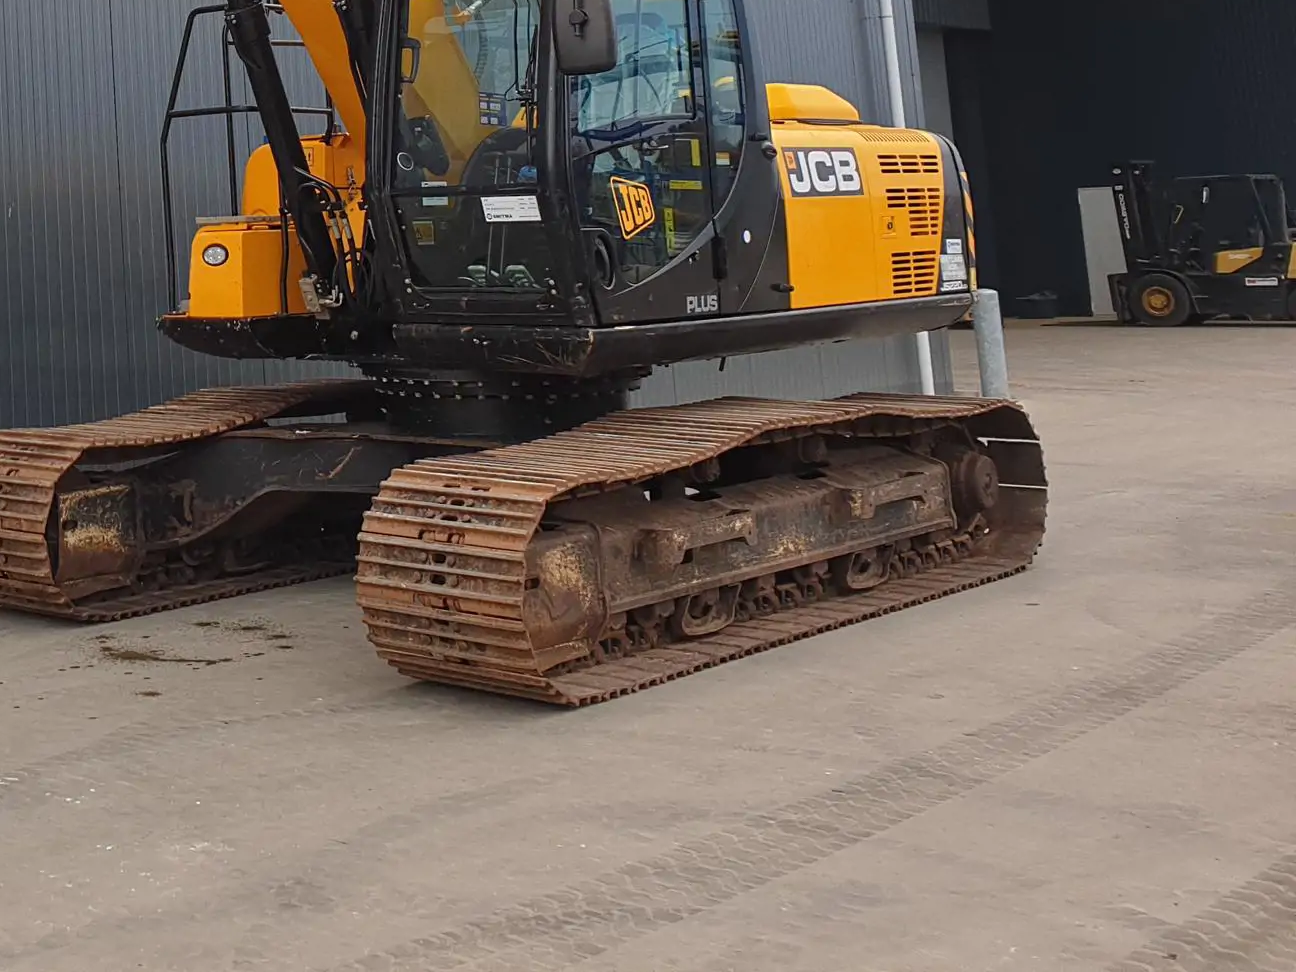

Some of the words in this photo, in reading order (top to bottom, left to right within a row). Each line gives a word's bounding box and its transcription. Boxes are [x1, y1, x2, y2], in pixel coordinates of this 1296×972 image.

[789, 151, 861, 193] JCB
[618, 184, 652, 232] JCB
[686, 295, 718, 313] PLUS
